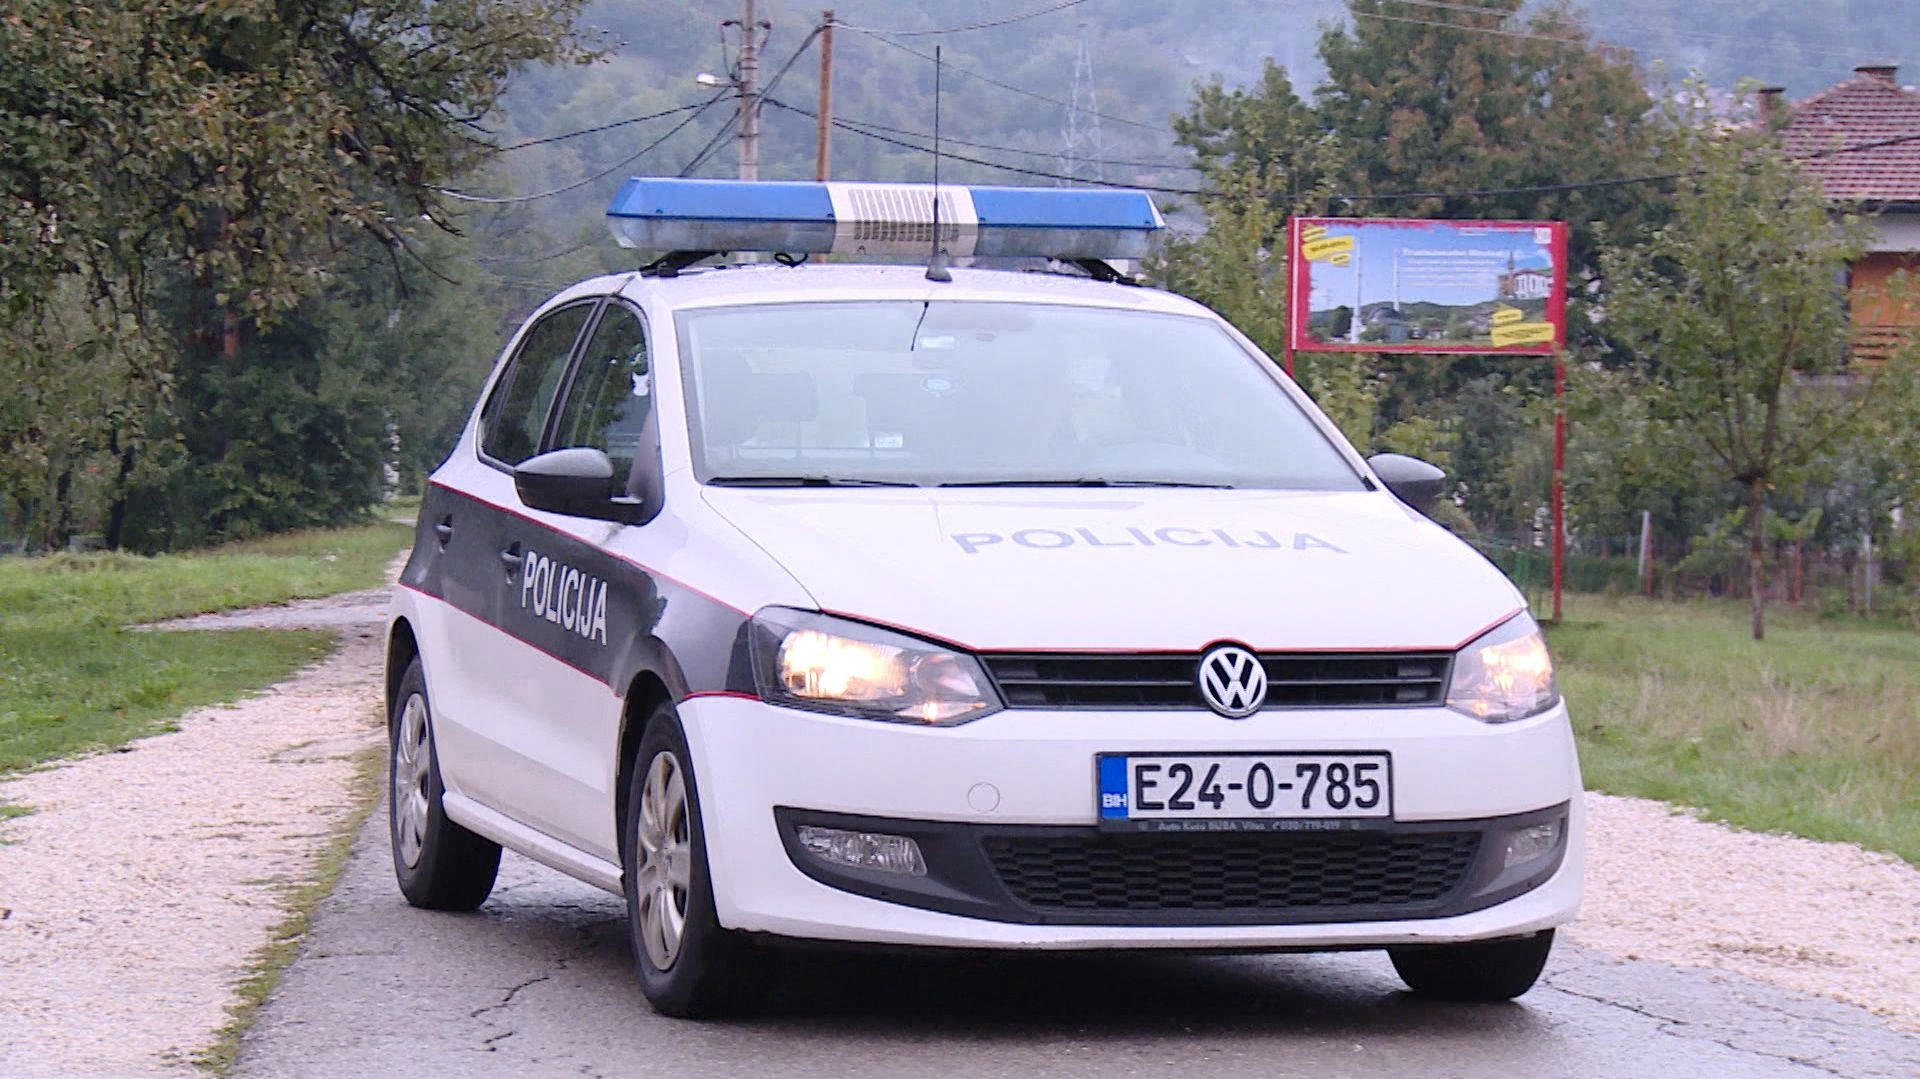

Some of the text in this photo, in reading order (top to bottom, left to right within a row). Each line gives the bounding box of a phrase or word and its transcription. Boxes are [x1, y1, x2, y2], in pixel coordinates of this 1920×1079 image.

[951, 527, 1350, 555] POLICIJA
[522, 551, 607, 646] POLICIJA
[1199, 646, 1268, 715] VW
[1103, 793, 1127, 808] BIH
